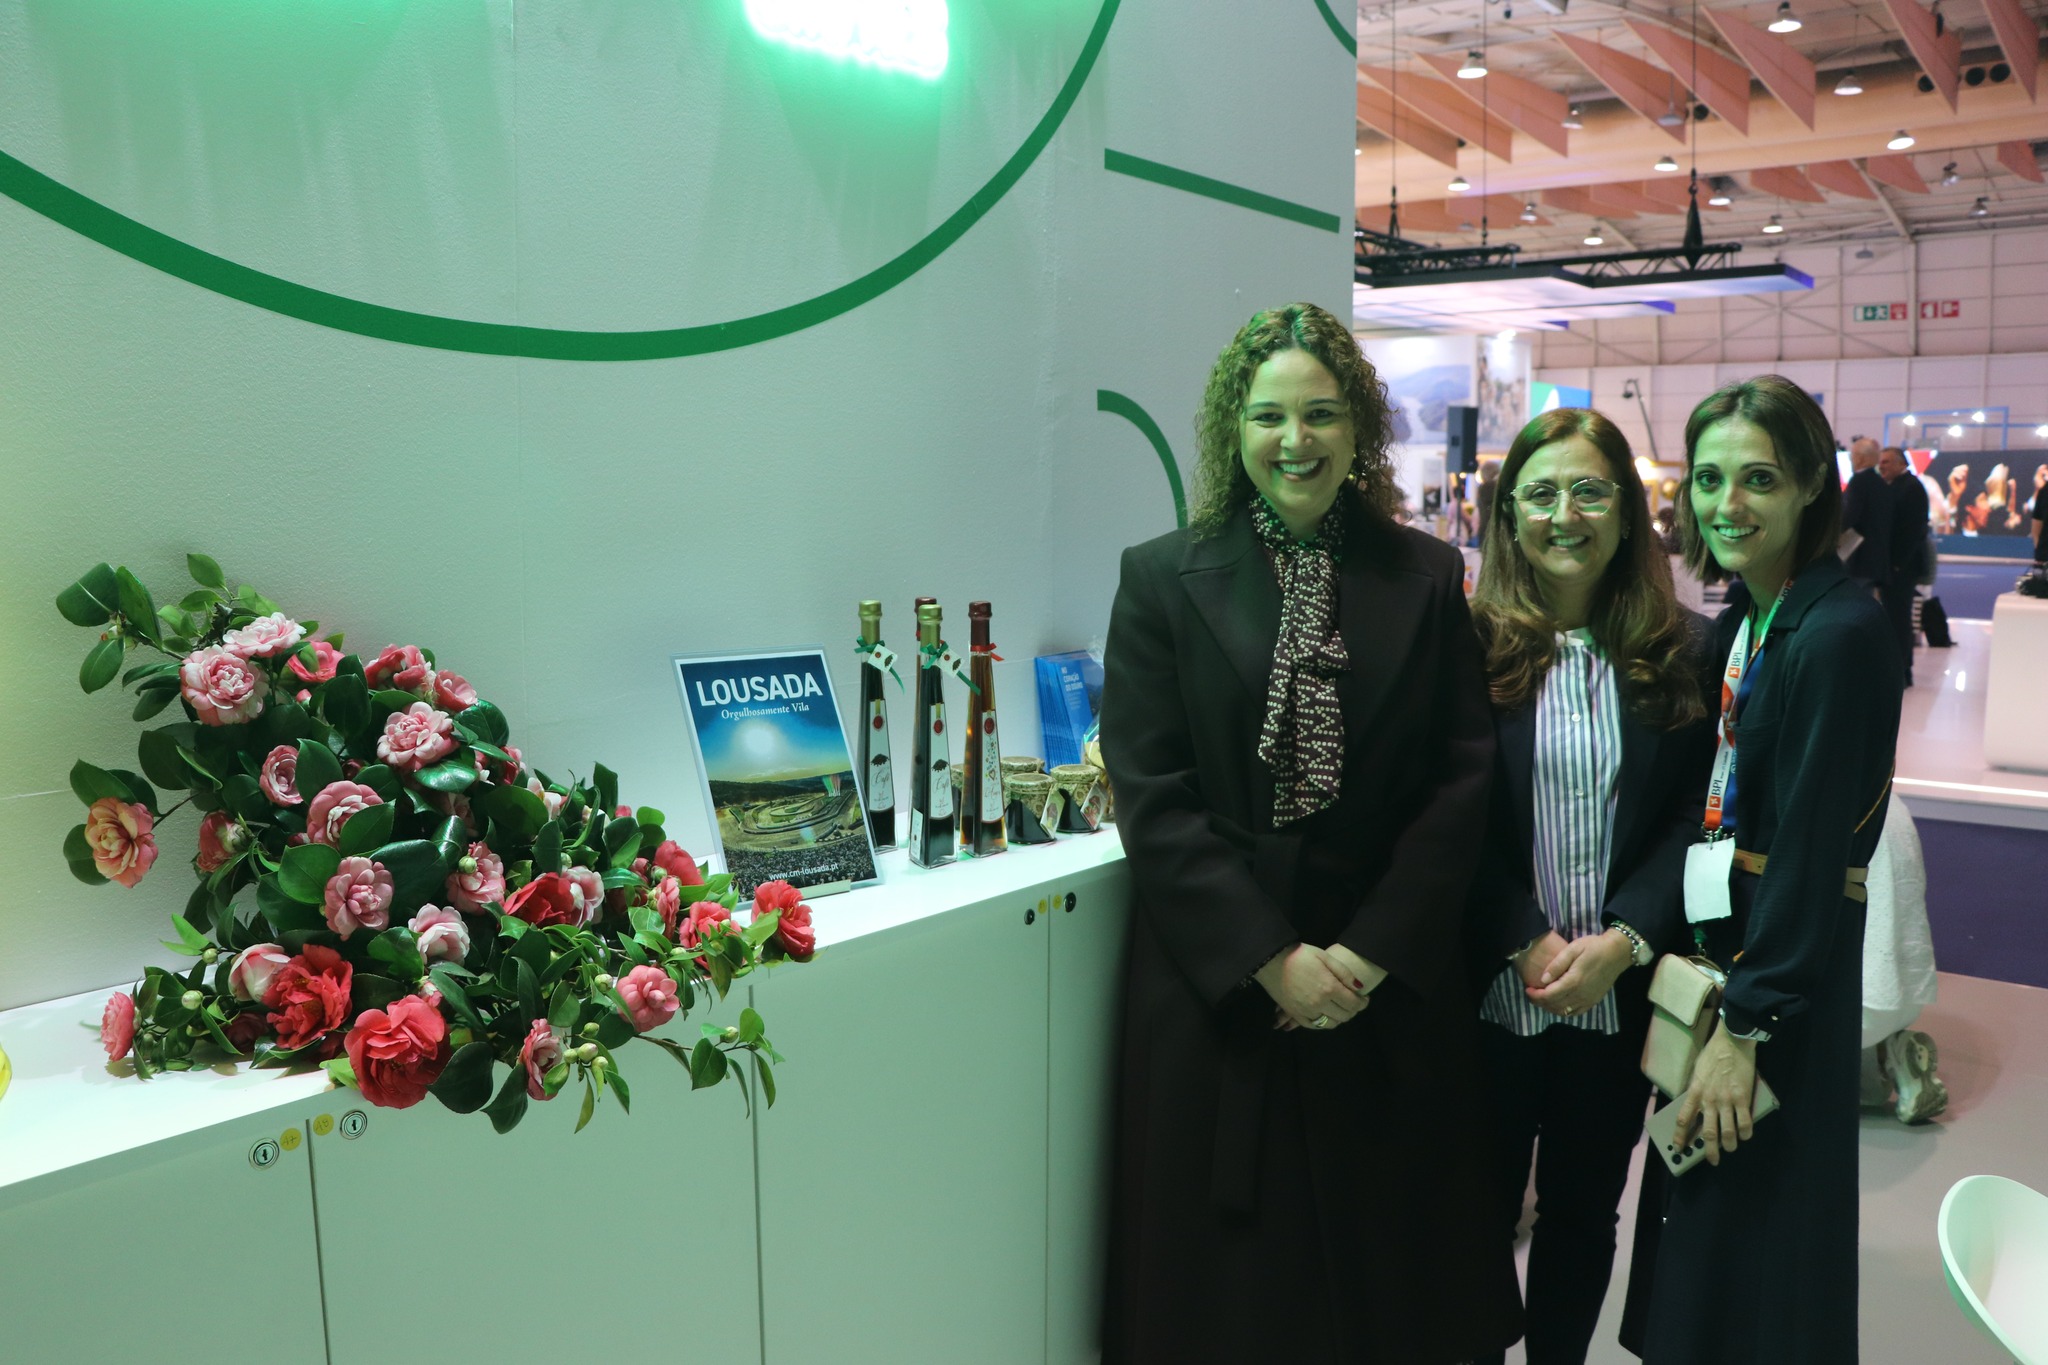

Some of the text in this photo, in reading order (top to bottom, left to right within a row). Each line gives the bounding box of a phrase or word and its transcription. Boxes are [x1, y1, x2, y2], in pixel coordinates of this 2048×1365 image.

[1731, 652, 1742, 667] BPI
[695, 672, 823, 707] LOUSADA
[721, 701, 810, 721] Orgulhosamente Vila
[1711, 779, 1723, 796] BPI
[768, 862, 839, 881] www.cm-lousada.pt
